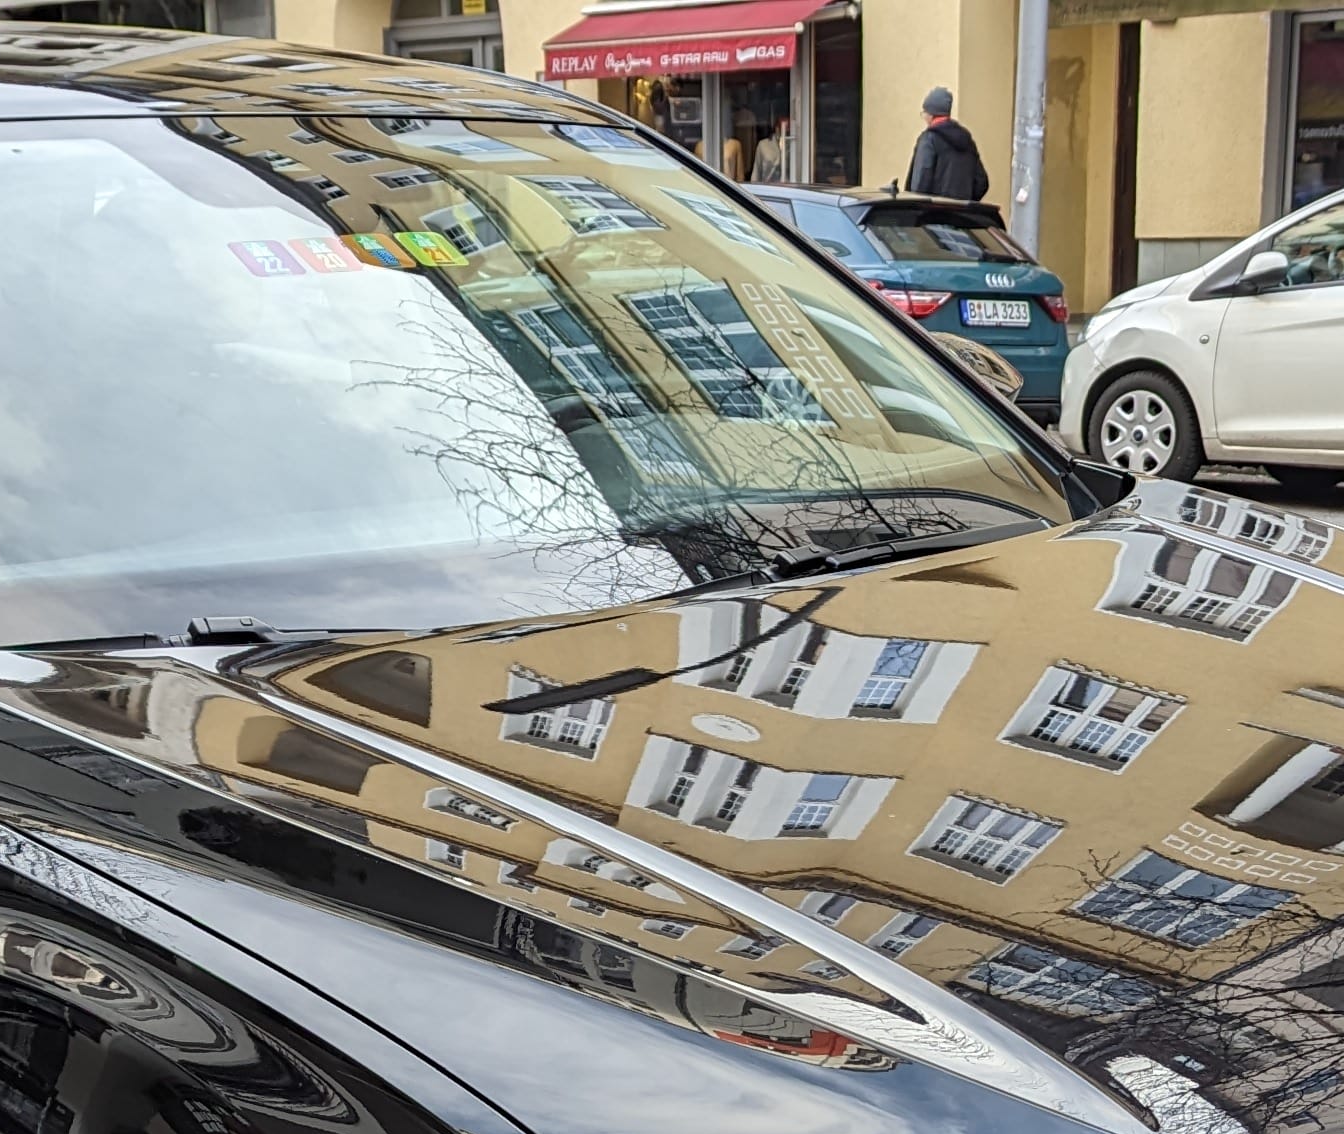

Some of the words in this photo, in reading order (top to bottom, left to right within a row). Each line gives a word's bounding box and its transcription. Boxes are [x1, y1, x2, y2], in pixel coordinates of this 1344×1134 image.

[552, 55, 598, 73] REPLAY
[660, 52, 701, 66] G-STAR
[756, 45, 786, 58] GAS
[257, 257, 291, 274] 22
[316, 252, 348, 270] 20
[984, 303, 1000, 319] LA
[1001, 303, 1028, 320] 3233
